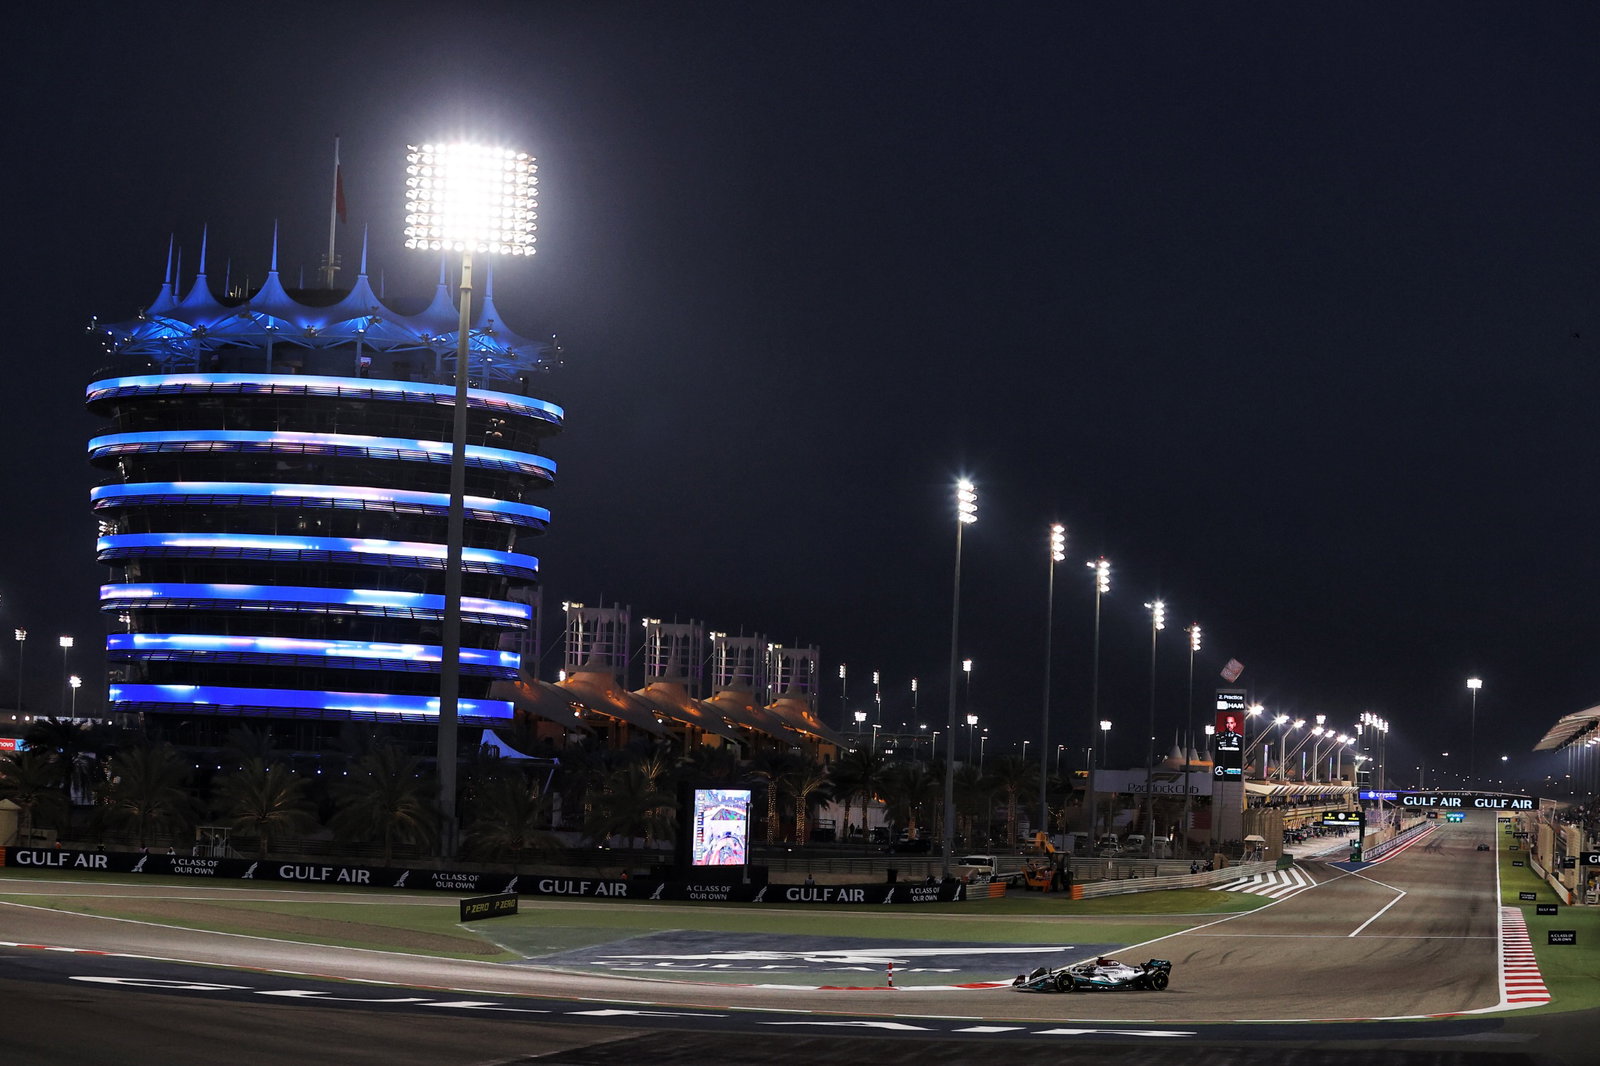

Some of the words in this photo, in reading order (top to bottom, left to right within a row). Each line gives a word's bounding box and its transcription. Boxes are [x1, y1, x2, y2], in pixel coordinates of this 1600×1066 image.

[1403, 796, 1438, 806] GULF
[1440, 797, 1462, 806] AIR
[1474, 798, 1508, 808] GULF
[1510, 800, 1532, 808] AIR
[16, 850, 70, 866] GULF
[74, 854, 108, 868] AIR
[178, 858, 206, 867] CLASS
[1589, 855, 1600, 863] G
[280, 864, 334, 880] GULF
[336, 868, 370, 884] AIR
[440, 873, 467, 881] CLASS
[539, 879, 591, 894] GULF
[595, 882, 627, 896] AIR
[786, 888, 834, 901] GULF
[837, 889, 864, 902] AIR
[466, 905, 471, 914] P
[472, 902, 490, 913] ZERO
[495, 901, 500, 910] P
[500, 899, 516, 909] ZERO
[68, 976, 730, 1018] GULF
[755, 1021, 1198, 1037] AIR
